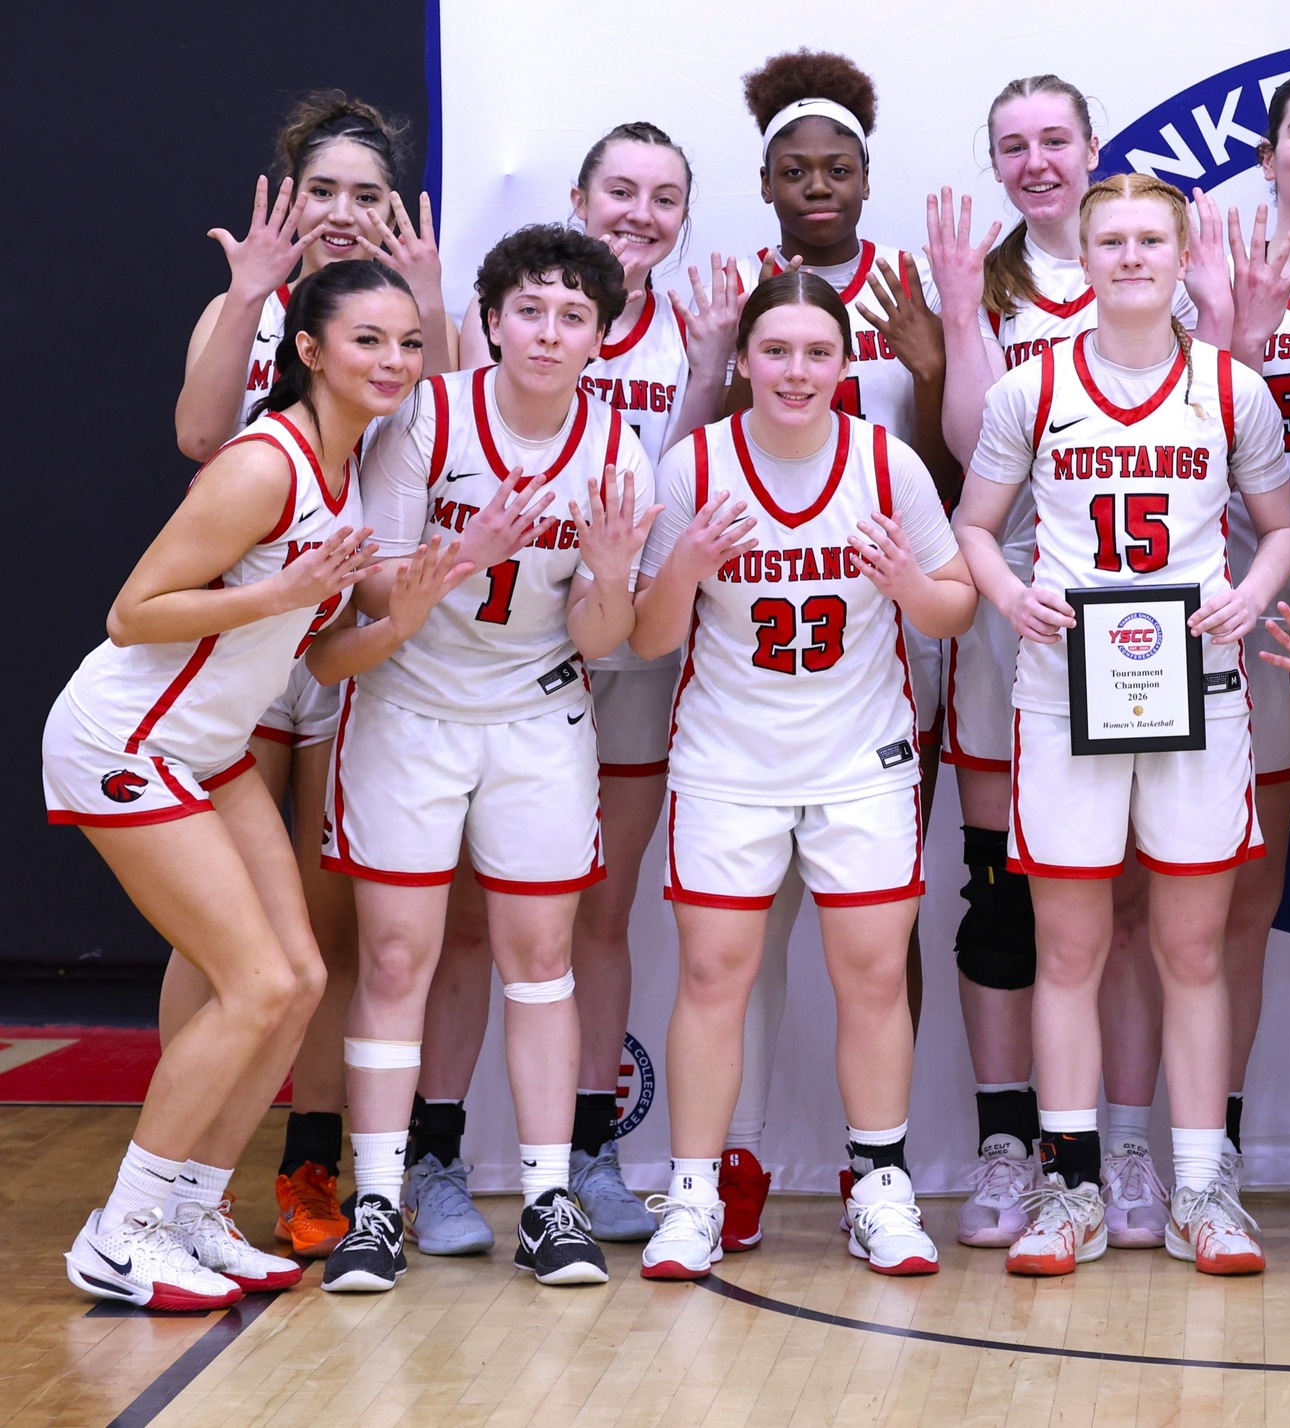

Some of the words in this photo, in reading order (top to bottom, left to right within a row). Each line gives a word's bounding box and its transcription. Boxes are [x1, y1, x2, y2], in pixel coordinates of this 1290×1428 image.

[1051, 445, 1210, 480] MUSTANGS
[1089, 492, 1171, 574] 15
[475, 558, 521, 626] 1
[750, 594, 848, 676] 23
[1109, 629, 1155, 644] YSCC
[1110, 668, 1164, 678] Tournament
[1114, 681, 1160, 691] Champion
[1127, 693, 1148, 701] 2026
[1102, 720, 1135, 730] Women's
[1136, 719, 1175, 728] Basketball
[634, 1048, 653, 1107] COLLEGE
